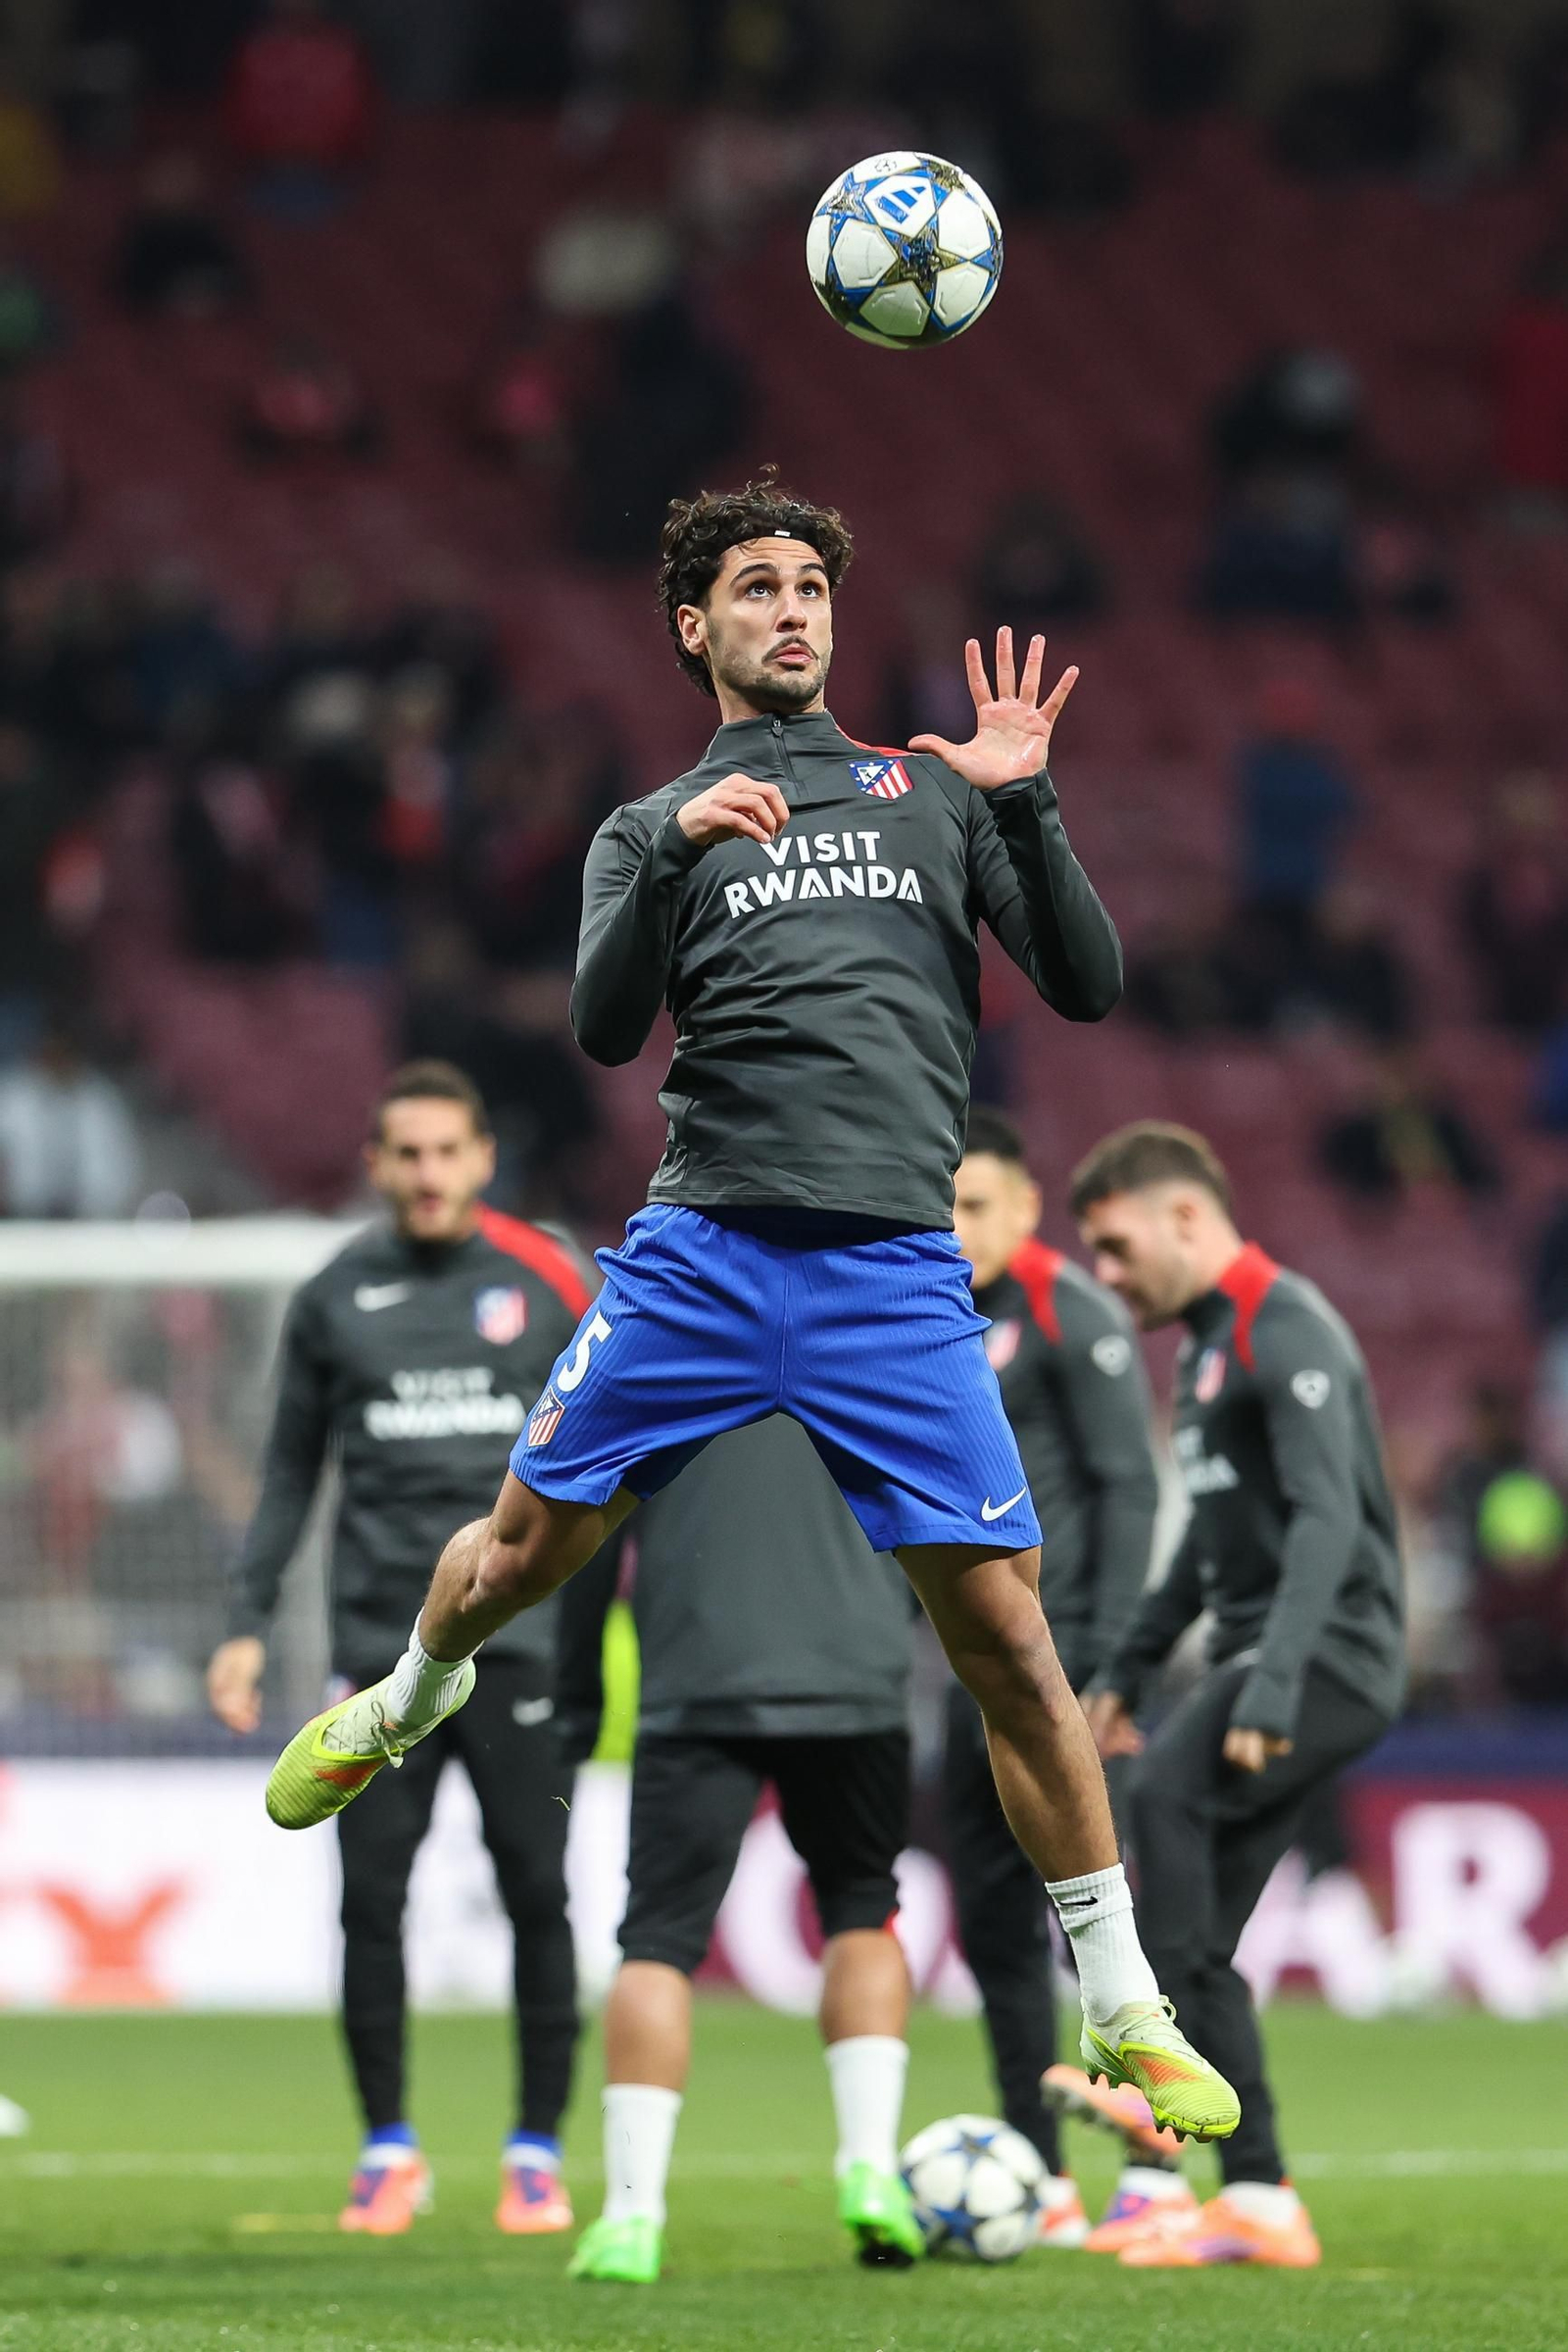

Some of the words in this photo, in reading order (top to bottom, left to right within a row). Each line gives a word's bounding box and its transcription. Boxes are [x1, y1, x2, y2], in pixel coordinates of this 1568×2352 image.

[759, 830, 881, 866] VISIT
[723, 865, 923, 919] RWANDA
[557, 1309, 612, 1393] 5
